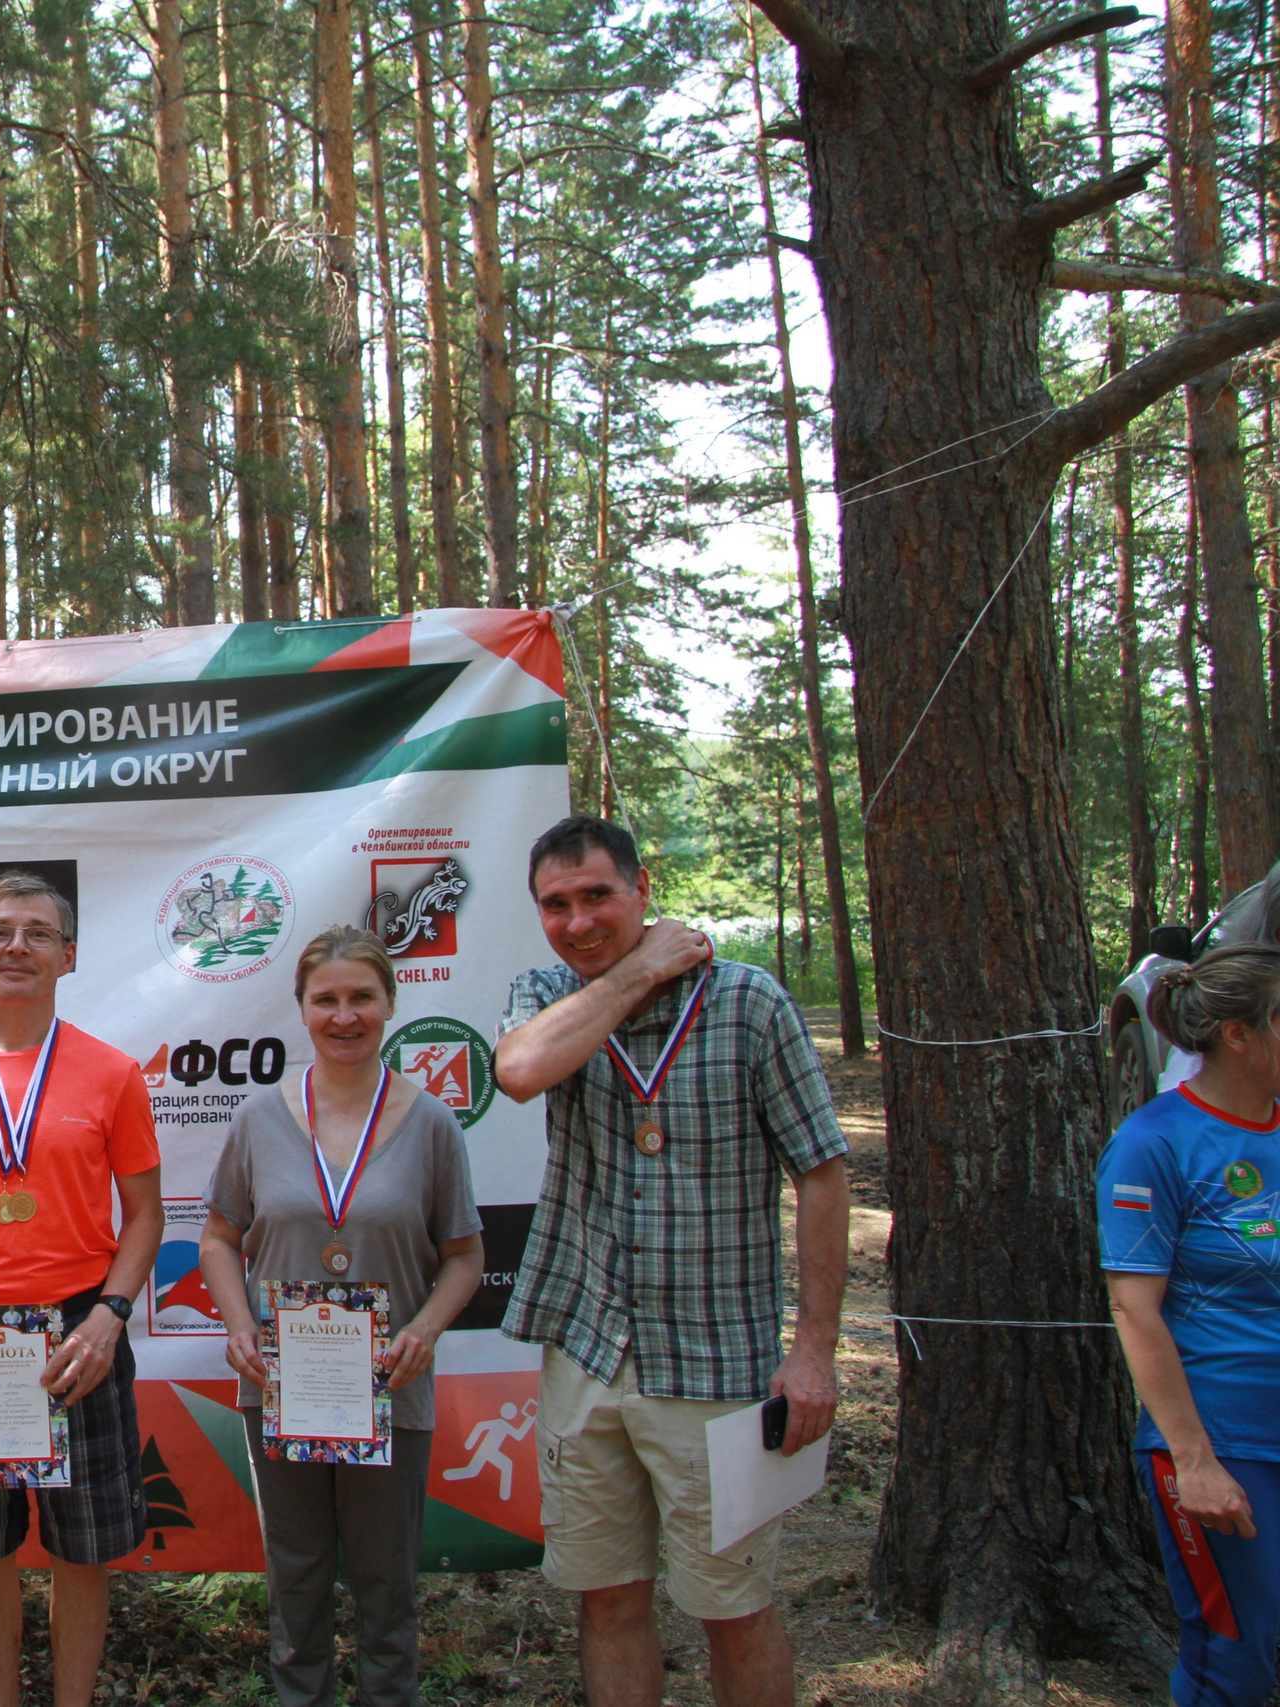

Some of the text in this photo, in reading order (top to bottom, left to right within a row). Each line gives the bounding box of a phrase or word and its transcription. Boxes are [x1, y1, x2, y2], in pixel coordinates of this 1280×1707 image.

[110, 749, 247, 787] ОКРУГ
[368, 828, 453, 840] Ориентирование
[361, 839, 424, 852] Челябинской
[427, 839, 470, 850] области
[158, 856, 292, 924] ФЕДЕРАЦИЯ СПОРТИВНОГО ОРИЕНТИРОВАНИЯ
[177, 957, 270, 982] КУРГАНСКОЙ ОБЛАСТИ
[396, 967, 450, 983] CHEL.RU
[170, 1037, 286, 1087] ФСО
[383, 1022, 492, 1115] ЕРАЦИЯ СПОРТИВНОГО ОРИЕНТИРОВАНИЯ
[150, 1095, 199, 1109] рация
[154, 1110, 233, 1127] нтирован
[1247, 1222, 1272, 1234] SFR
[289, 1322, 361, 1336] ГРАМОТА
